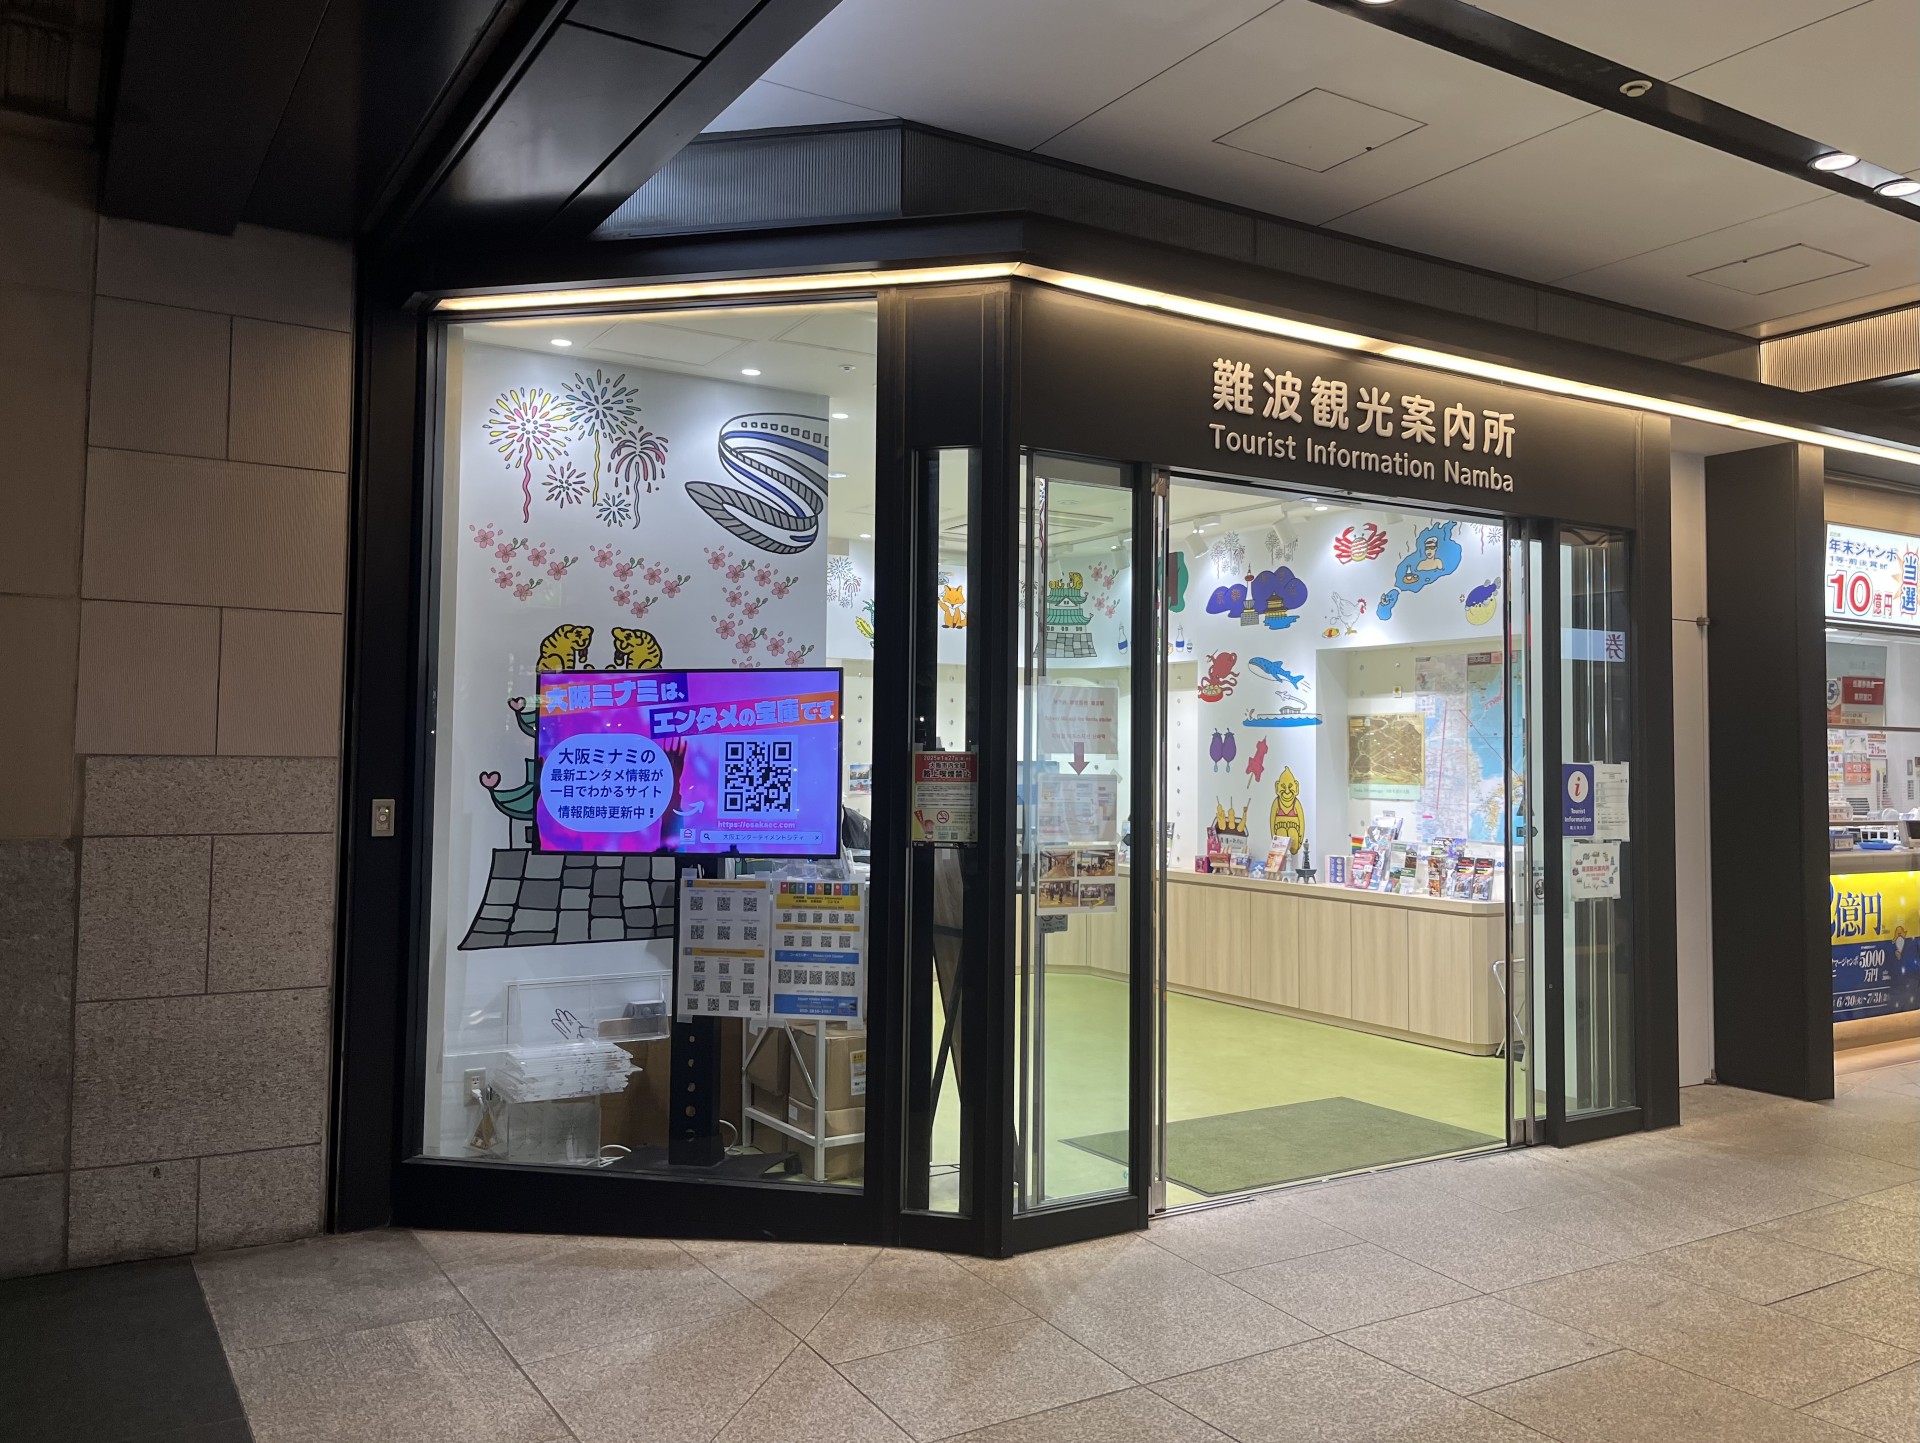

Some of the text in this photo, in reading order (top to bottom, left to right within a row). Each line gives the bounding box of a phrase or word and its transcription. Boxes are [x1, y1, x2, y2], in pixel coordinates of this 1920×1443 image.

[1212, 357, 1516, 459] 難波観光案内所
[1209, 423, 1515, 493] Tourist Information Namba
[1829, 538, 1897, 562] 年末ジャンボ
[1830, 573, 1893, 617] 10億円
[1902, 555, 1917, 612] 当選
[545, 679, 686, 714] 大阪ミナミは、
[653, 698, 835, 734] エンタメの宝庫です
[558, 747, 656, 764] 大阪ミナミの
[550, 768, 664, 782] 最新エンタメ情報が
[550, 785, 662, 798] 一目でわかるサイト
[557, 805, 655, 819] 情報随時更新中！
[1830, 881, 1882, 938] 億円
